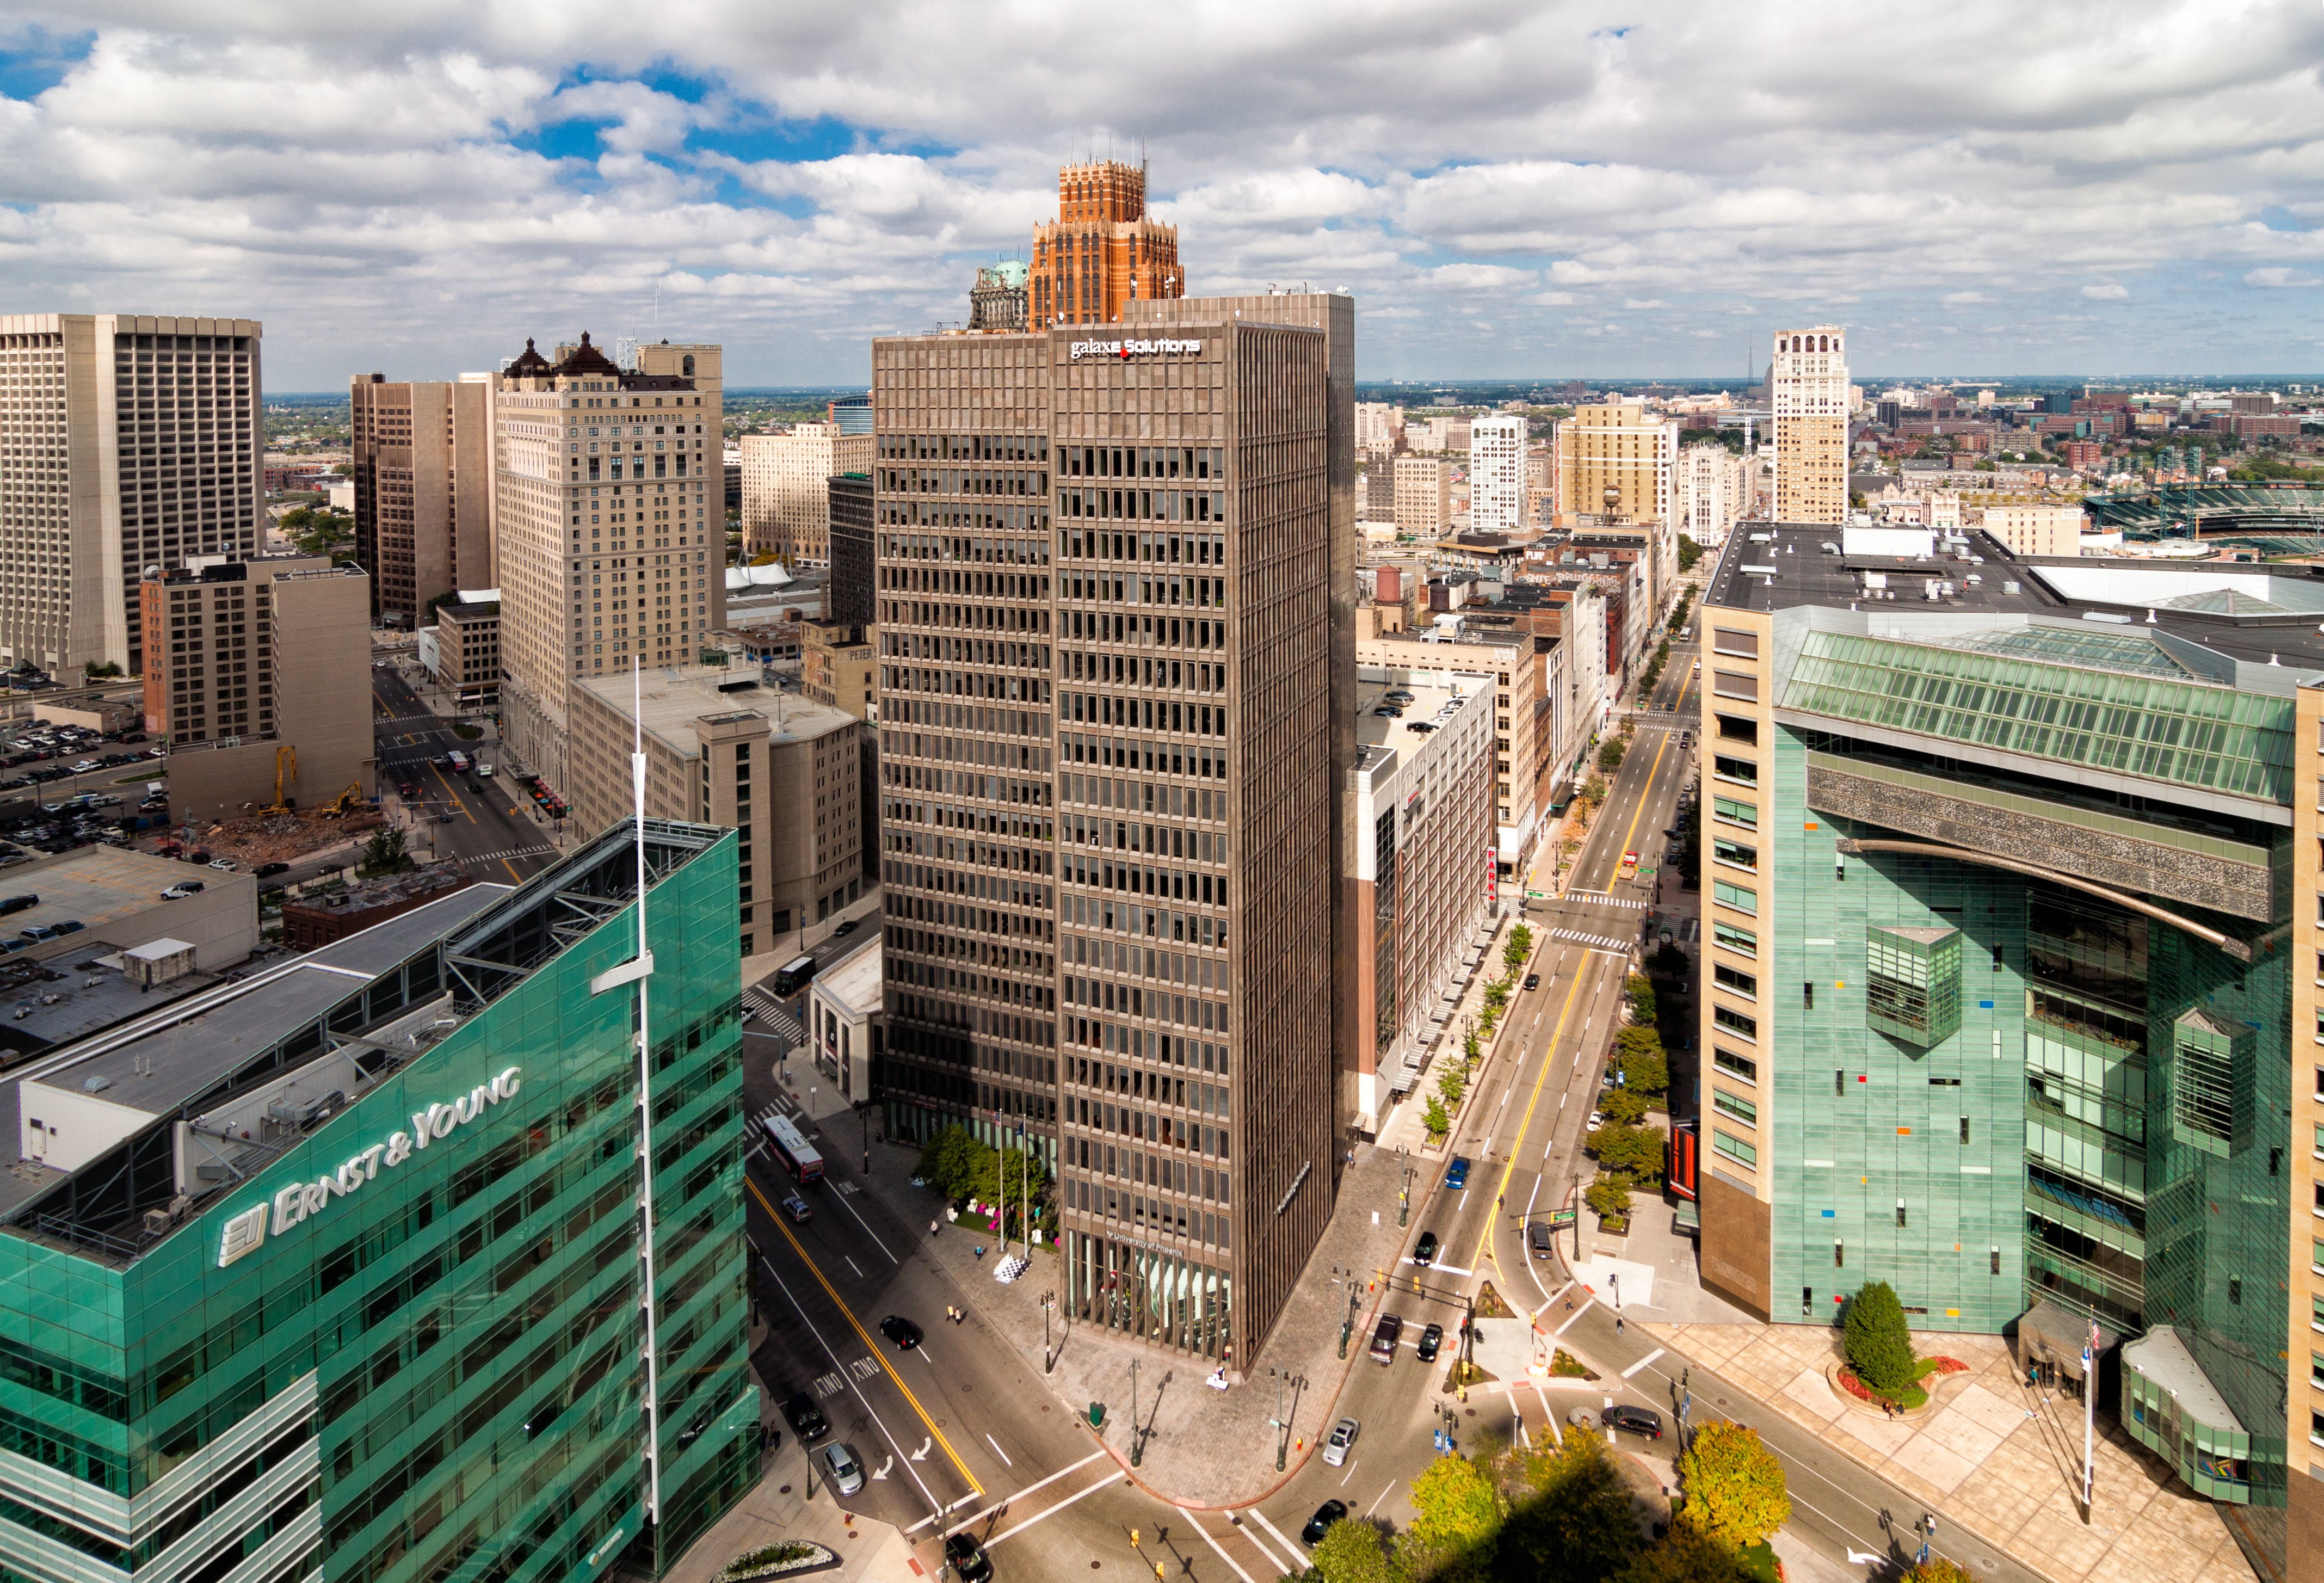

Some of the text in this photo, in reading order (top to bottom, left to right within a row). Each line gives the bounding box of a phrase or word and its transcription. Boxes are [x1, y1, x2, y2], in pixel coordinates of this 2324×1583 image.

[850, 649, 871, 661] PETER
[270, 1143, 385, 1236] ERNST
[384, 1132, 411, 1167] &
[412, 1067, 521, 1149] YOUNG
[839, 1181, 862, 1194] ONL
[1114, 1233, 1147, 1248] University
[1156, 1243, 1183, 1257] Phoenix
[849, 1357, 879, 1381] ONLY
[813, 1372, 843, 1399] ONLY
